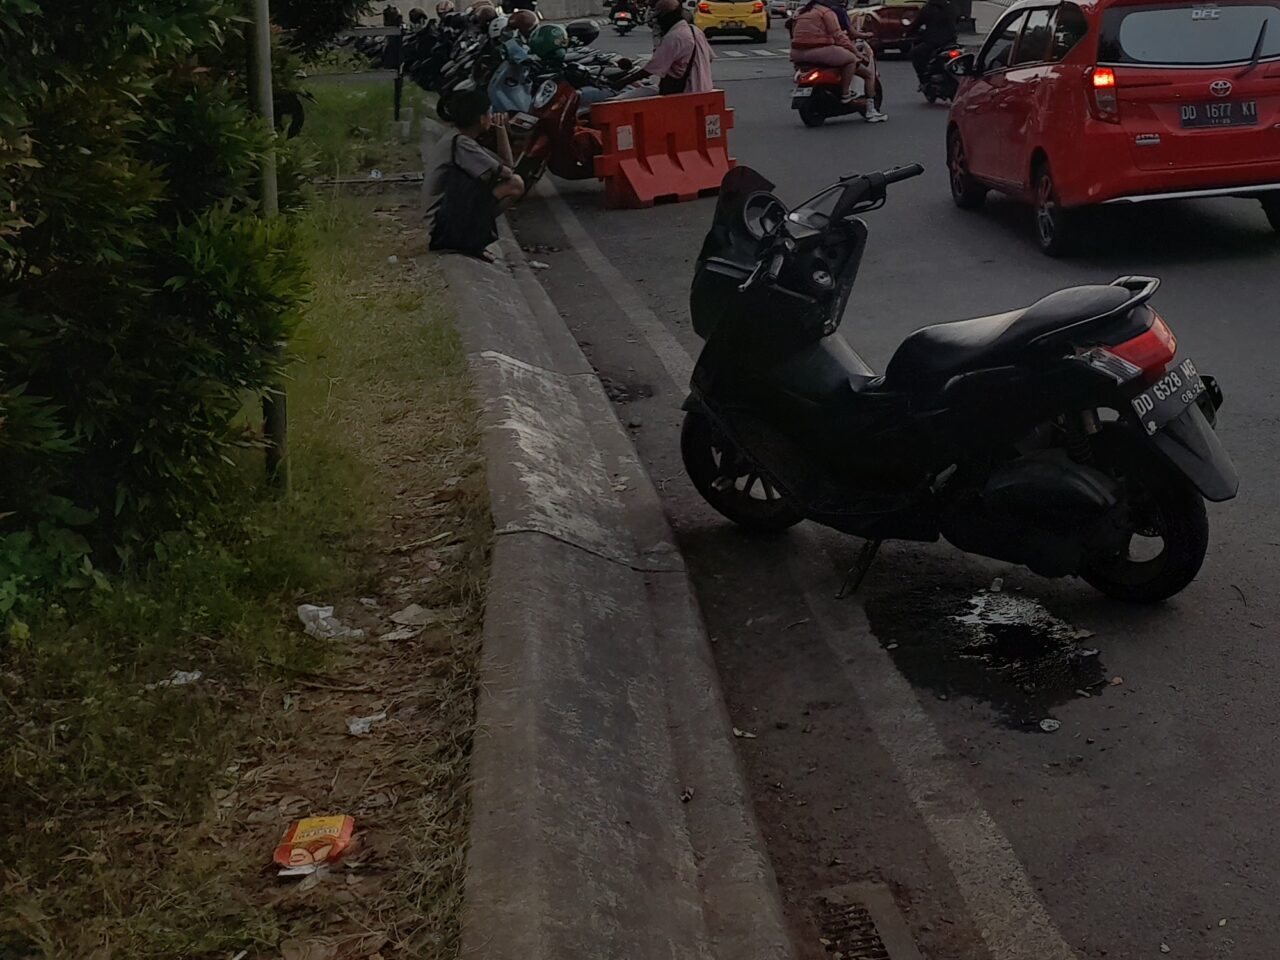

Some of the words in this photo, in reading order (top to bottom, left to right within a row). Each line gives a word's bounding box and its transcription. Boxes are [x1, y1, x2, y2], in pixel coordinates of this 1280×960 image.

[1182, 105, 1196, 120] DD
[1206, 103, 1232, 118] 1677
[1241, 101, 1256, 116] KT
[1133, 393, 1154, 416] DD
[1153, 371, 1182, 400] 6528
[1180, 358, 1197, 381] MB
